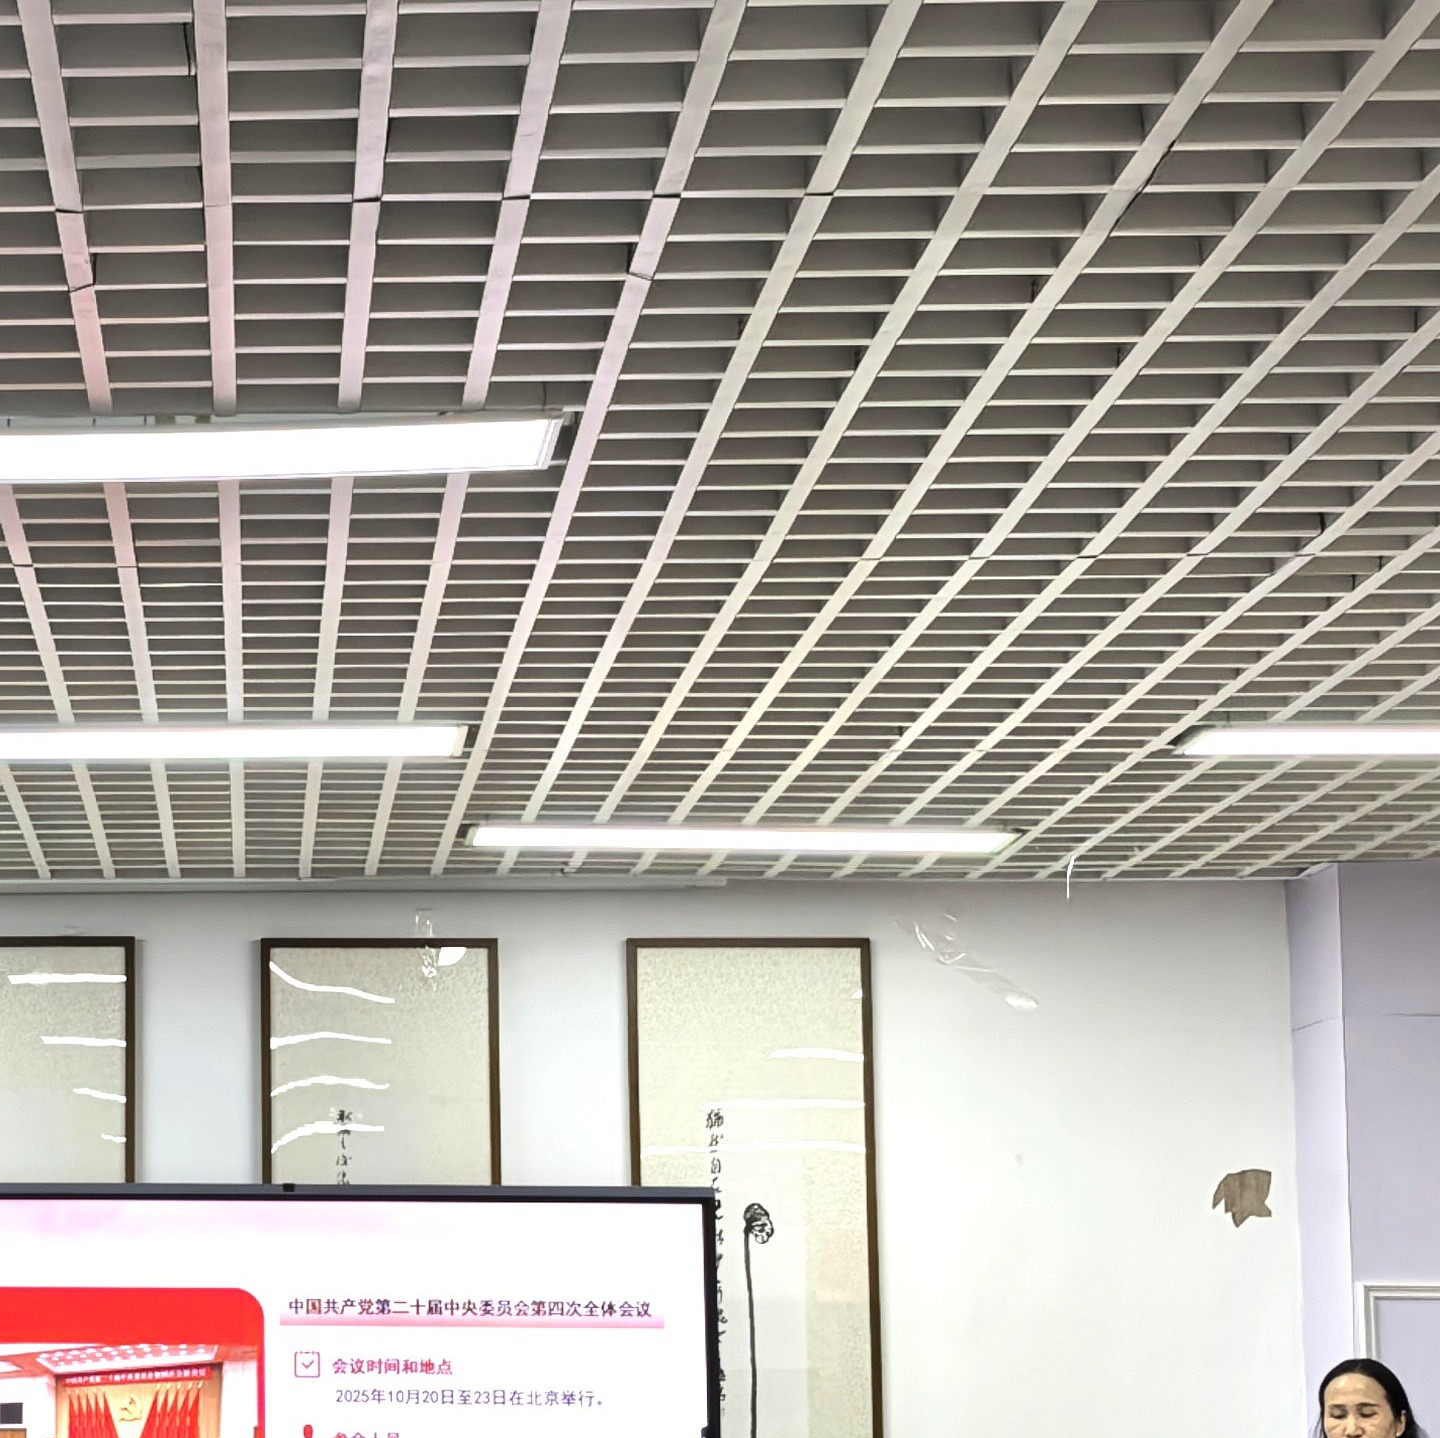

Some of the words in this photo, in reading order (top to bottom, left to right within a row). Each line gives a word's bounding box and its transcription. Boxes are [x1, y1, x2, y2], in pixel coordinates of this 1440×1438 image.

[288, 1297, 652, 1318] 中国共产党第二十届中央委员会第四次全体会议
[332, 1358, 453, 1375] 会议时间和地点
[336, 1389, 604, 1408] 2025年10月20日至23日在北京举行。
